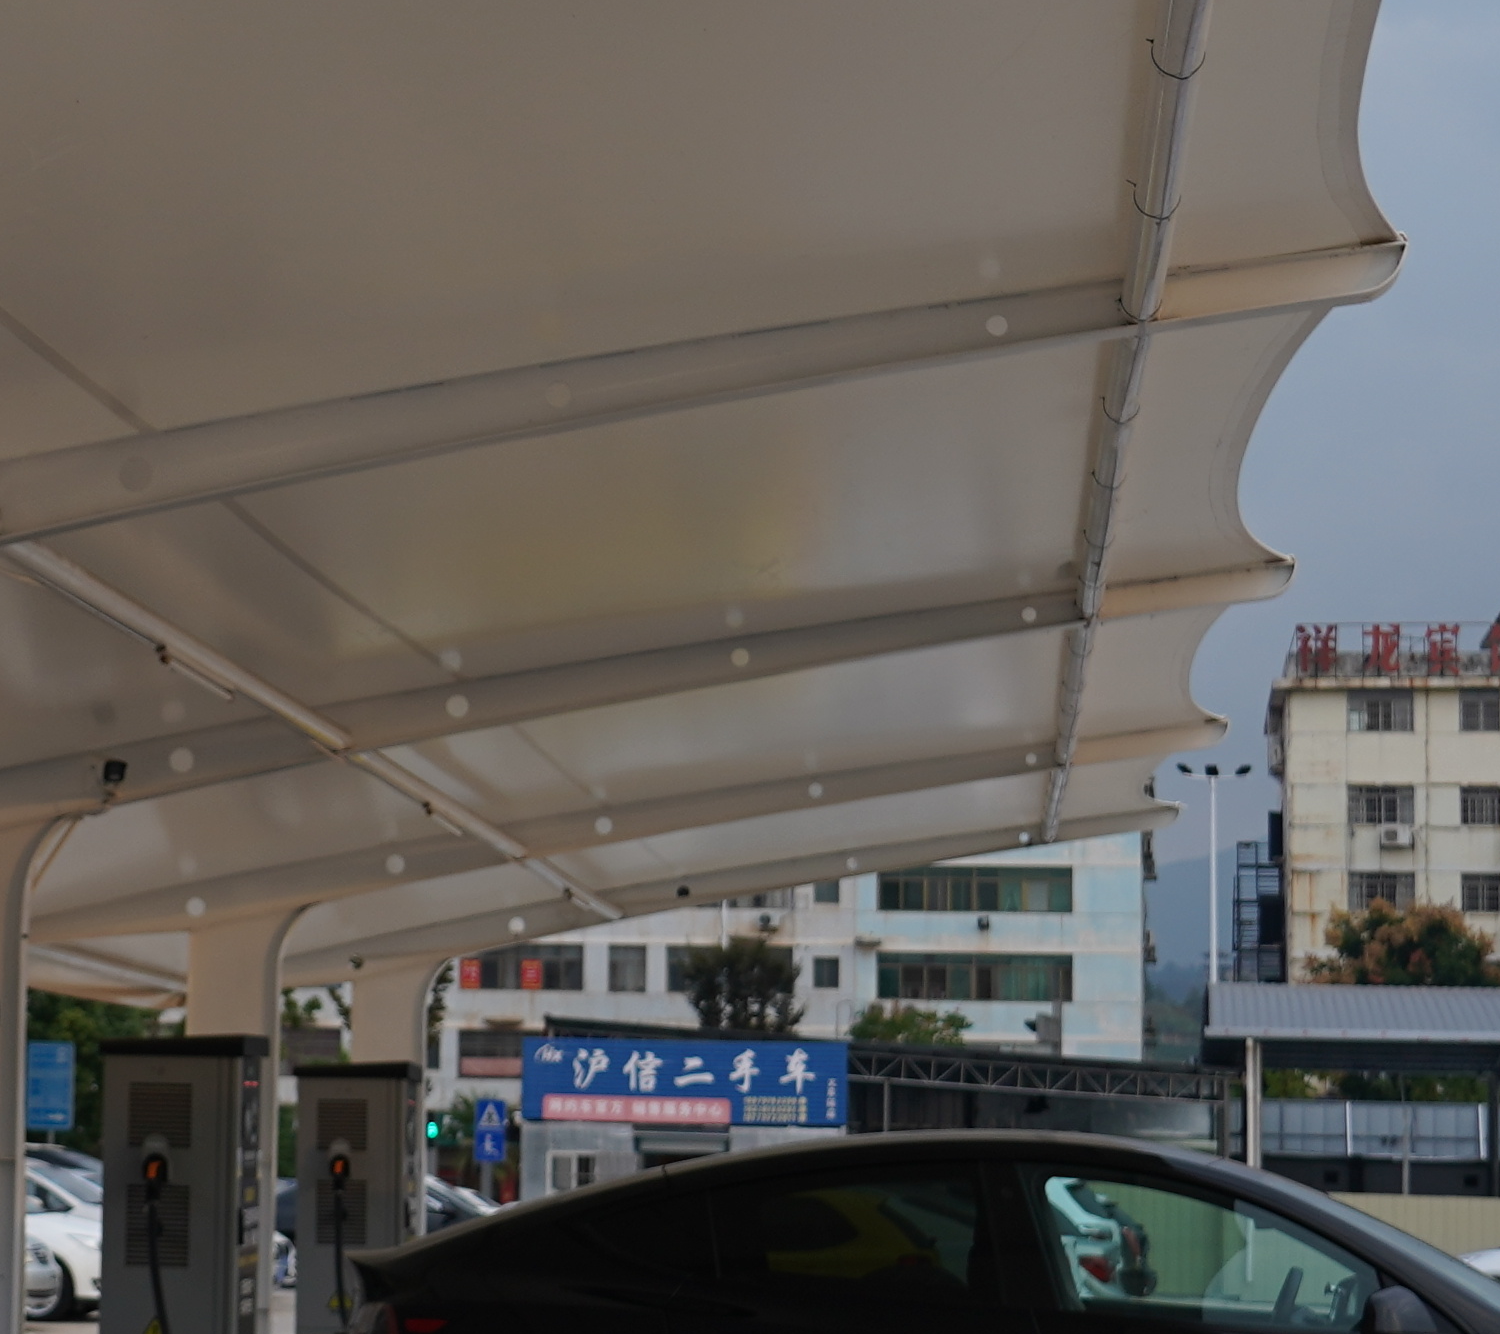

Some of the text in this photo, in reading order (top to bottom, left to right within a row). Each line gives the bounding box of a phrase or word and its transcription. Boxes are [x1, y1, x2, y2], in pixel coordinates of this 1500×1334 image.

[572, 1048, 817, 1094] 沪信二手车
